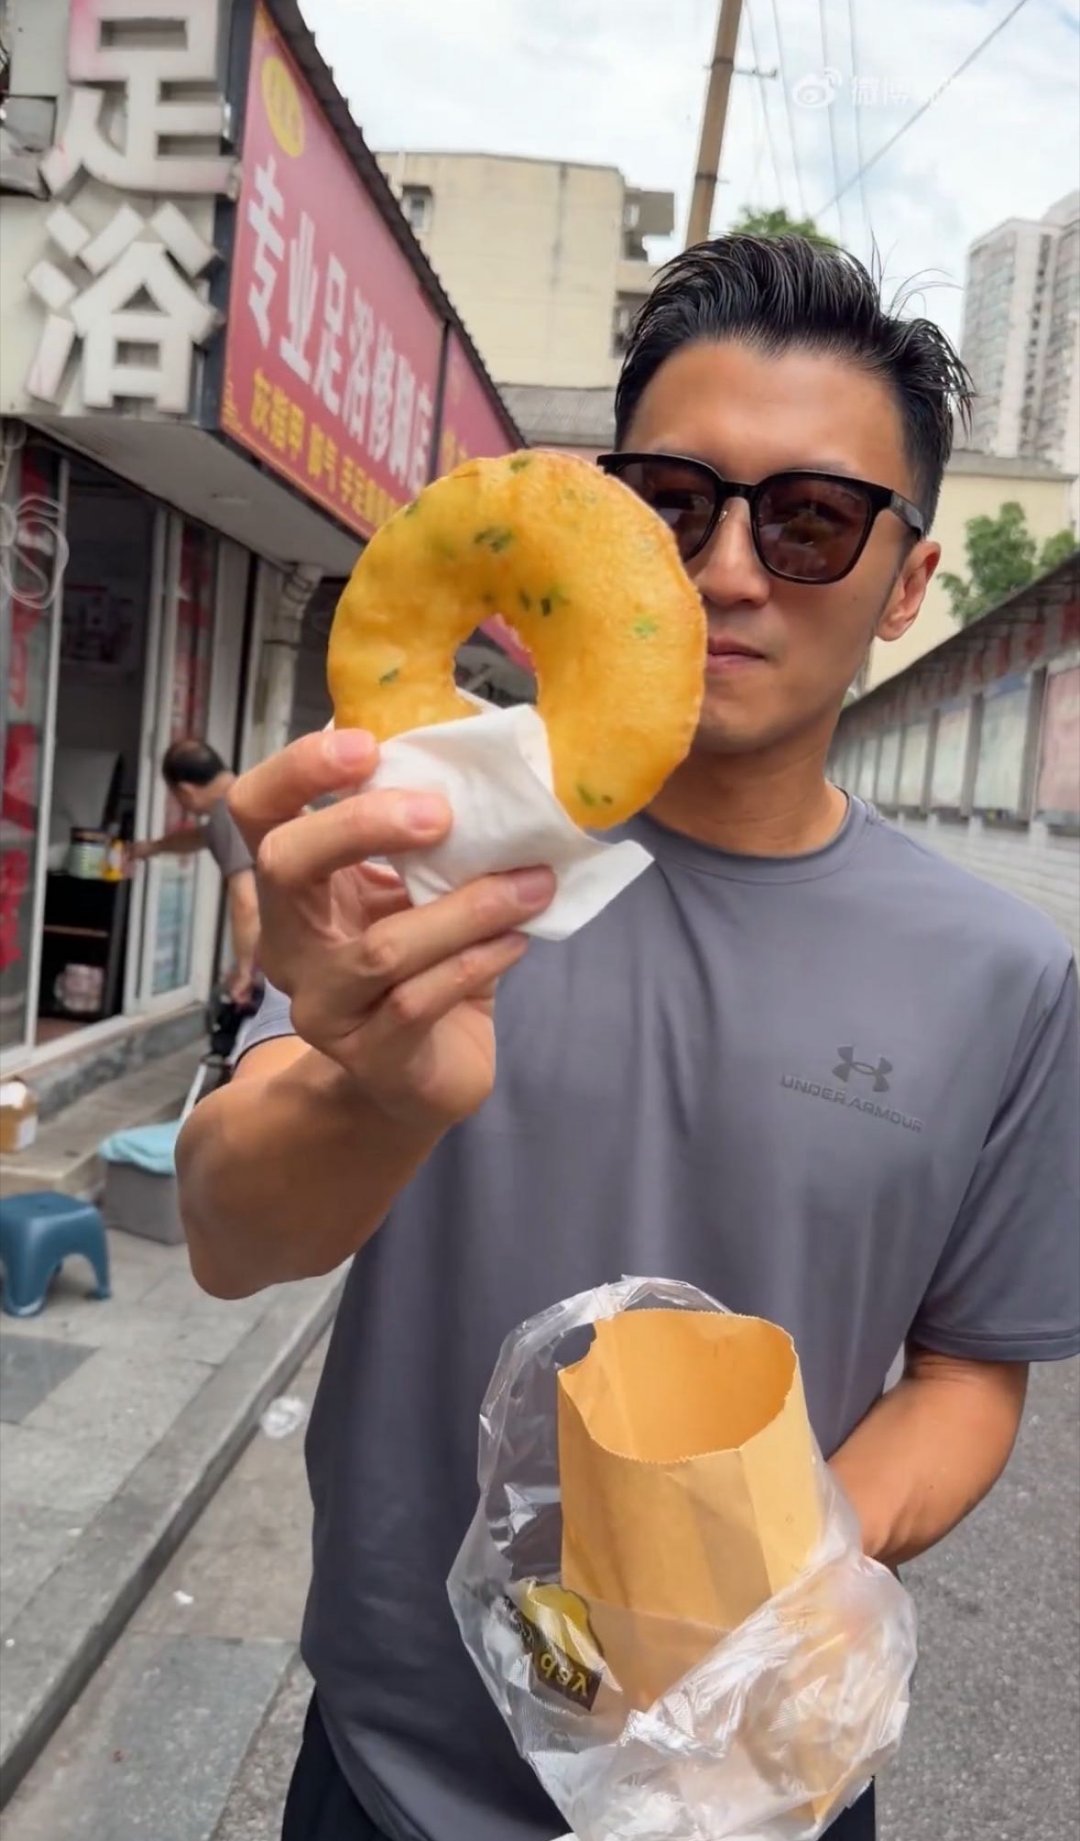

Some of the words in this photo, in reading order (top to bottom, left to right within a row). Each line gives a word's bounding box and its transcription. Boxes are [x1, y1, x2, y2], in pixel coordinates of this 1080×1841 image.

[26, 0, 241, 414] 足浴
[780, 1074, 846, 1105] UNDER
[848, 1096, 924, 1133] ARMOUR
